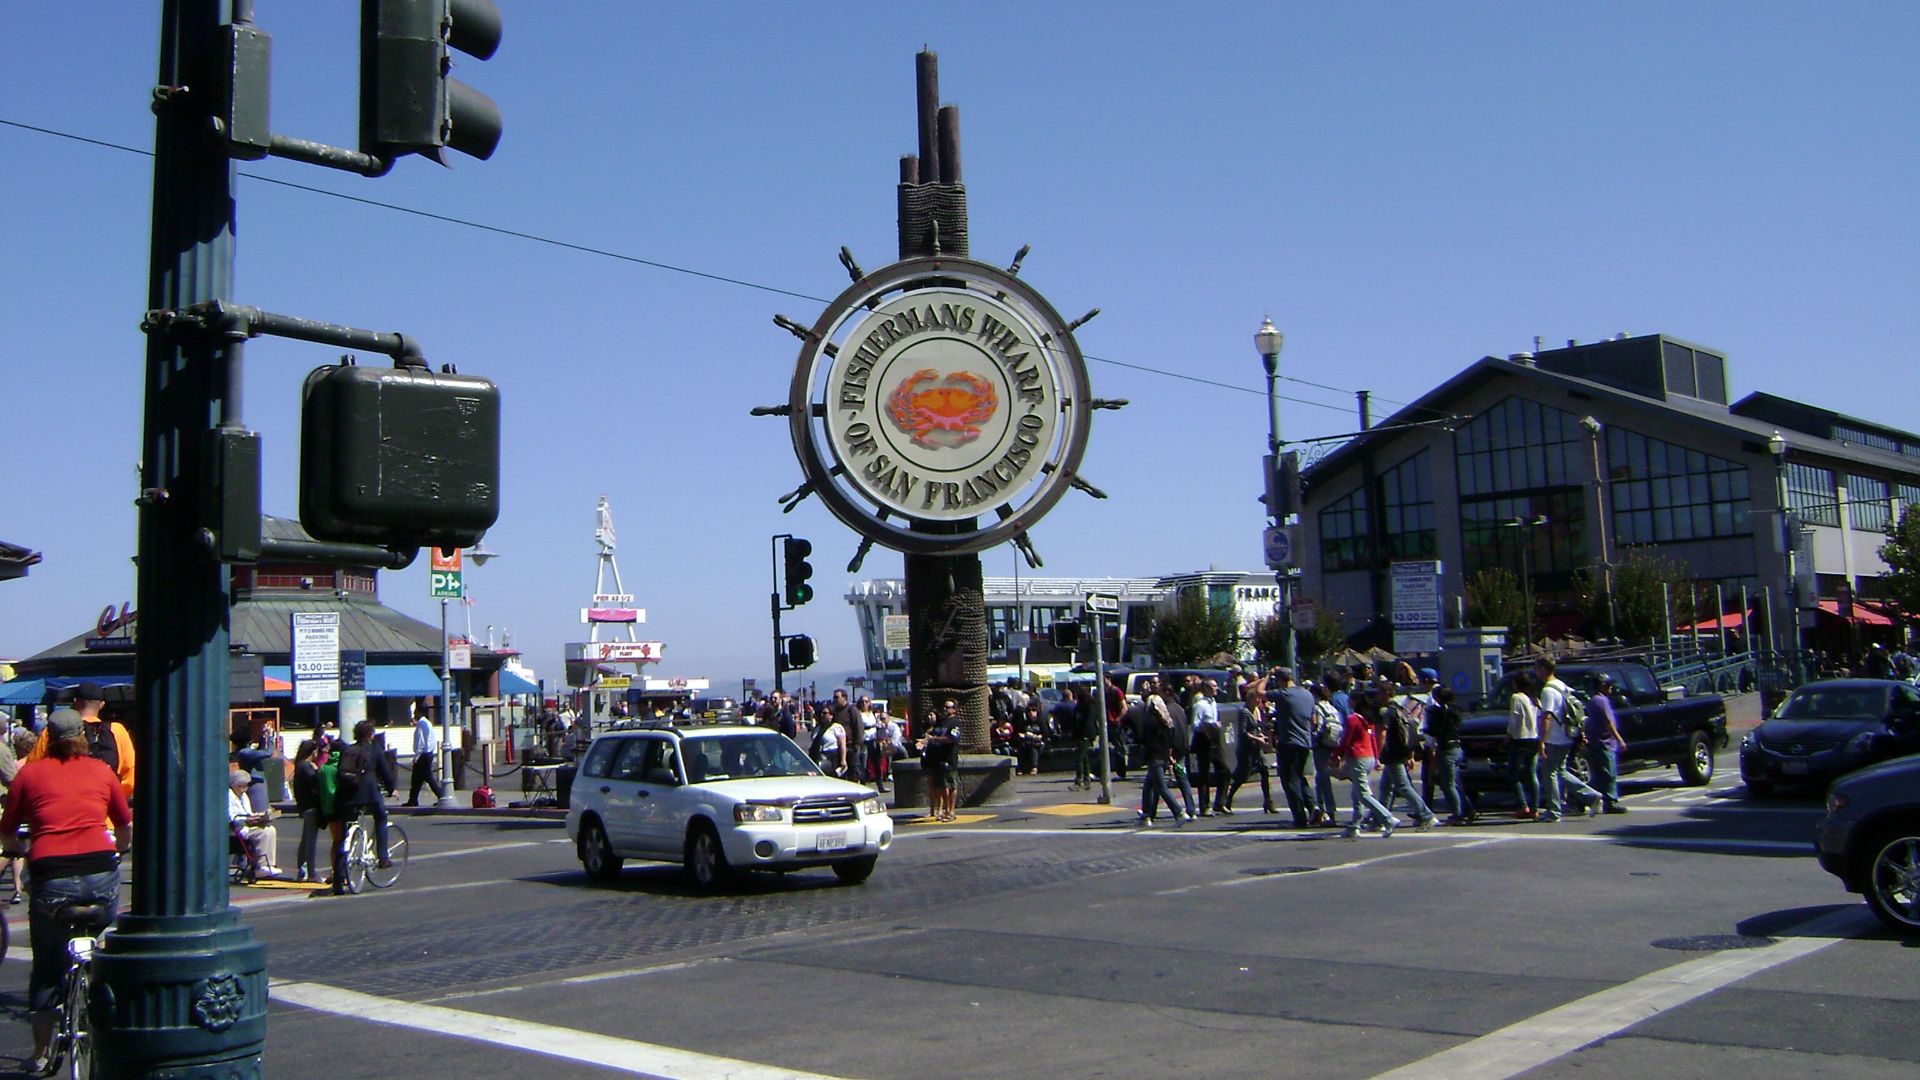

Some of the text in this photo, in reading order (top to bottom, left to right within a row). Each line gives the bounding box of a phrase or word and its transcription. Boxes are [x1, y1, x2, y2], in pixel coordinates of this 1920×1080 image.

[839, 303, 1045, 412] FISHERMANS WHARF
[844, 414, 1044, 511] OF SAN FRANCISCO
[1095, 598, 1116, 608] ONE WAY
[1395, 613, 1420, 621] $3.00
[297, 663, 322, 672] $3.00
